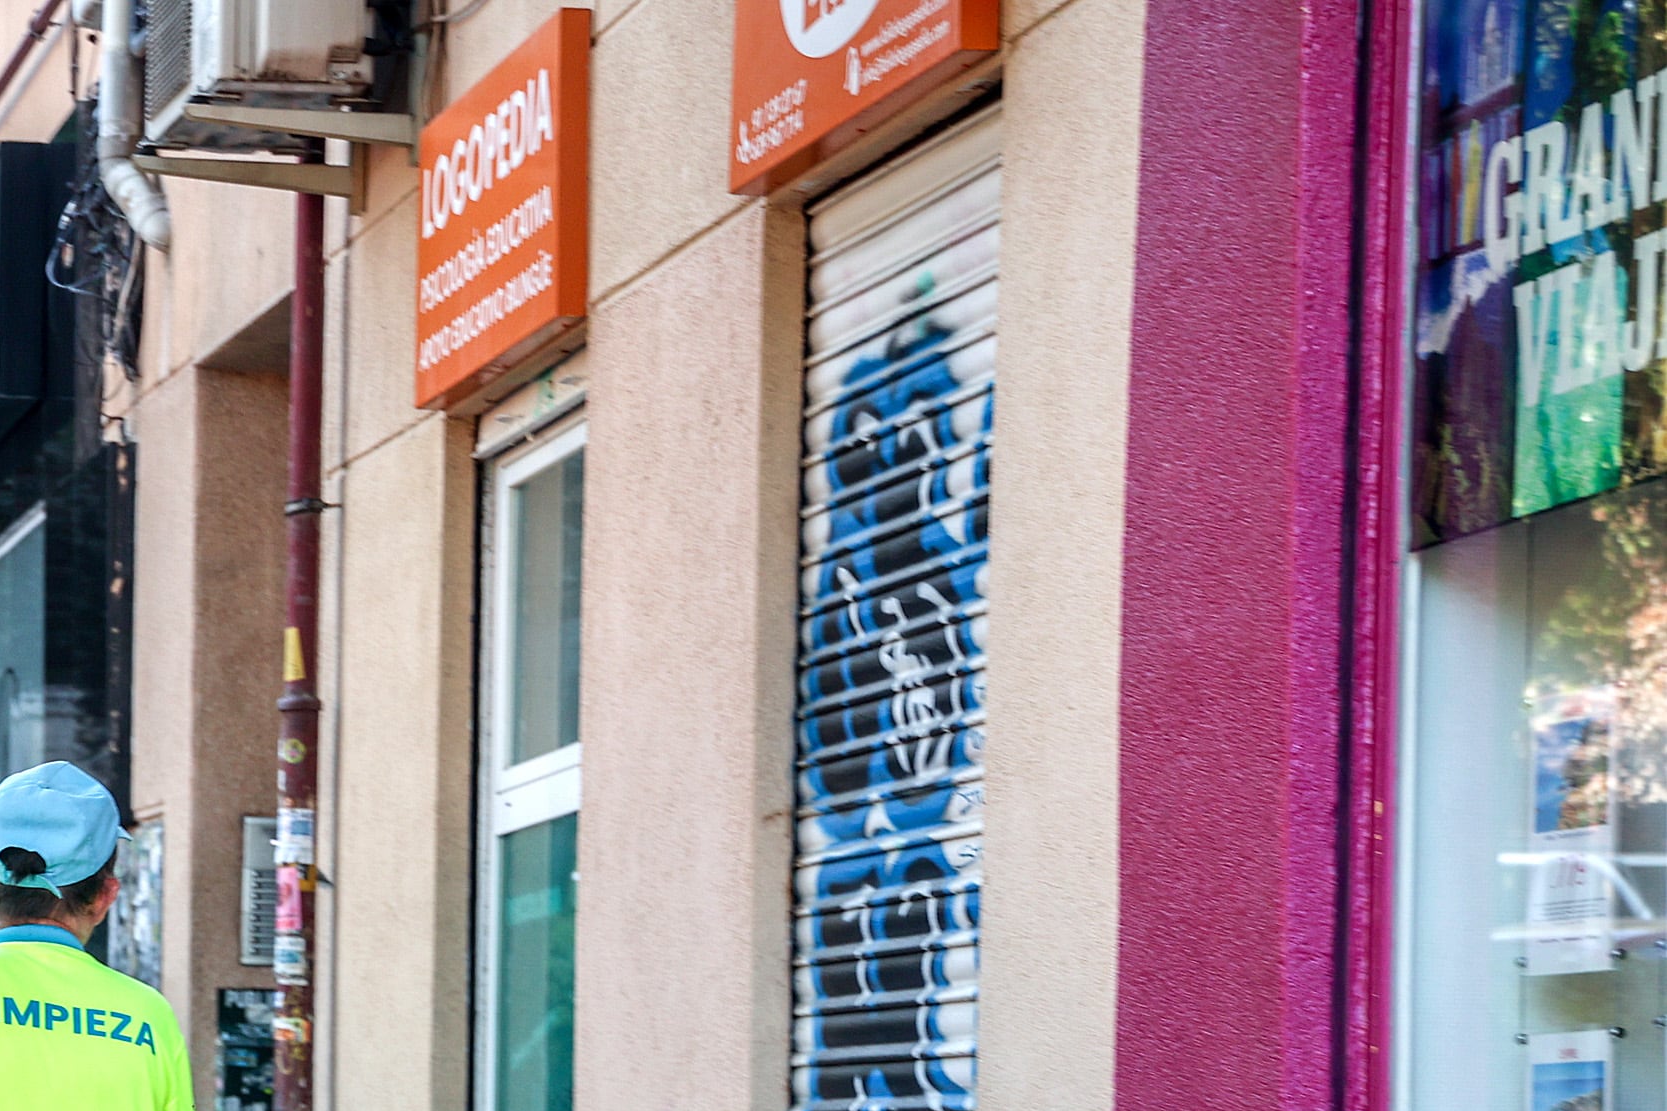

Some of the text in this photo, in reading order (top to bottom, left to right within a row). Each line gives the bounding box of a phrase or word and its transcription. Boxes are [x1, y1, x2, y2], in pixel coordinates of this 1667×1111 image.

[421, 68, 554, 239] LOGOPEDIA
[486, 184, 554, 266] EDUCATIVA
[452, 287, 509, 352] EDUCATIVO
[1513, 226, 1667, 407] VIAJ
